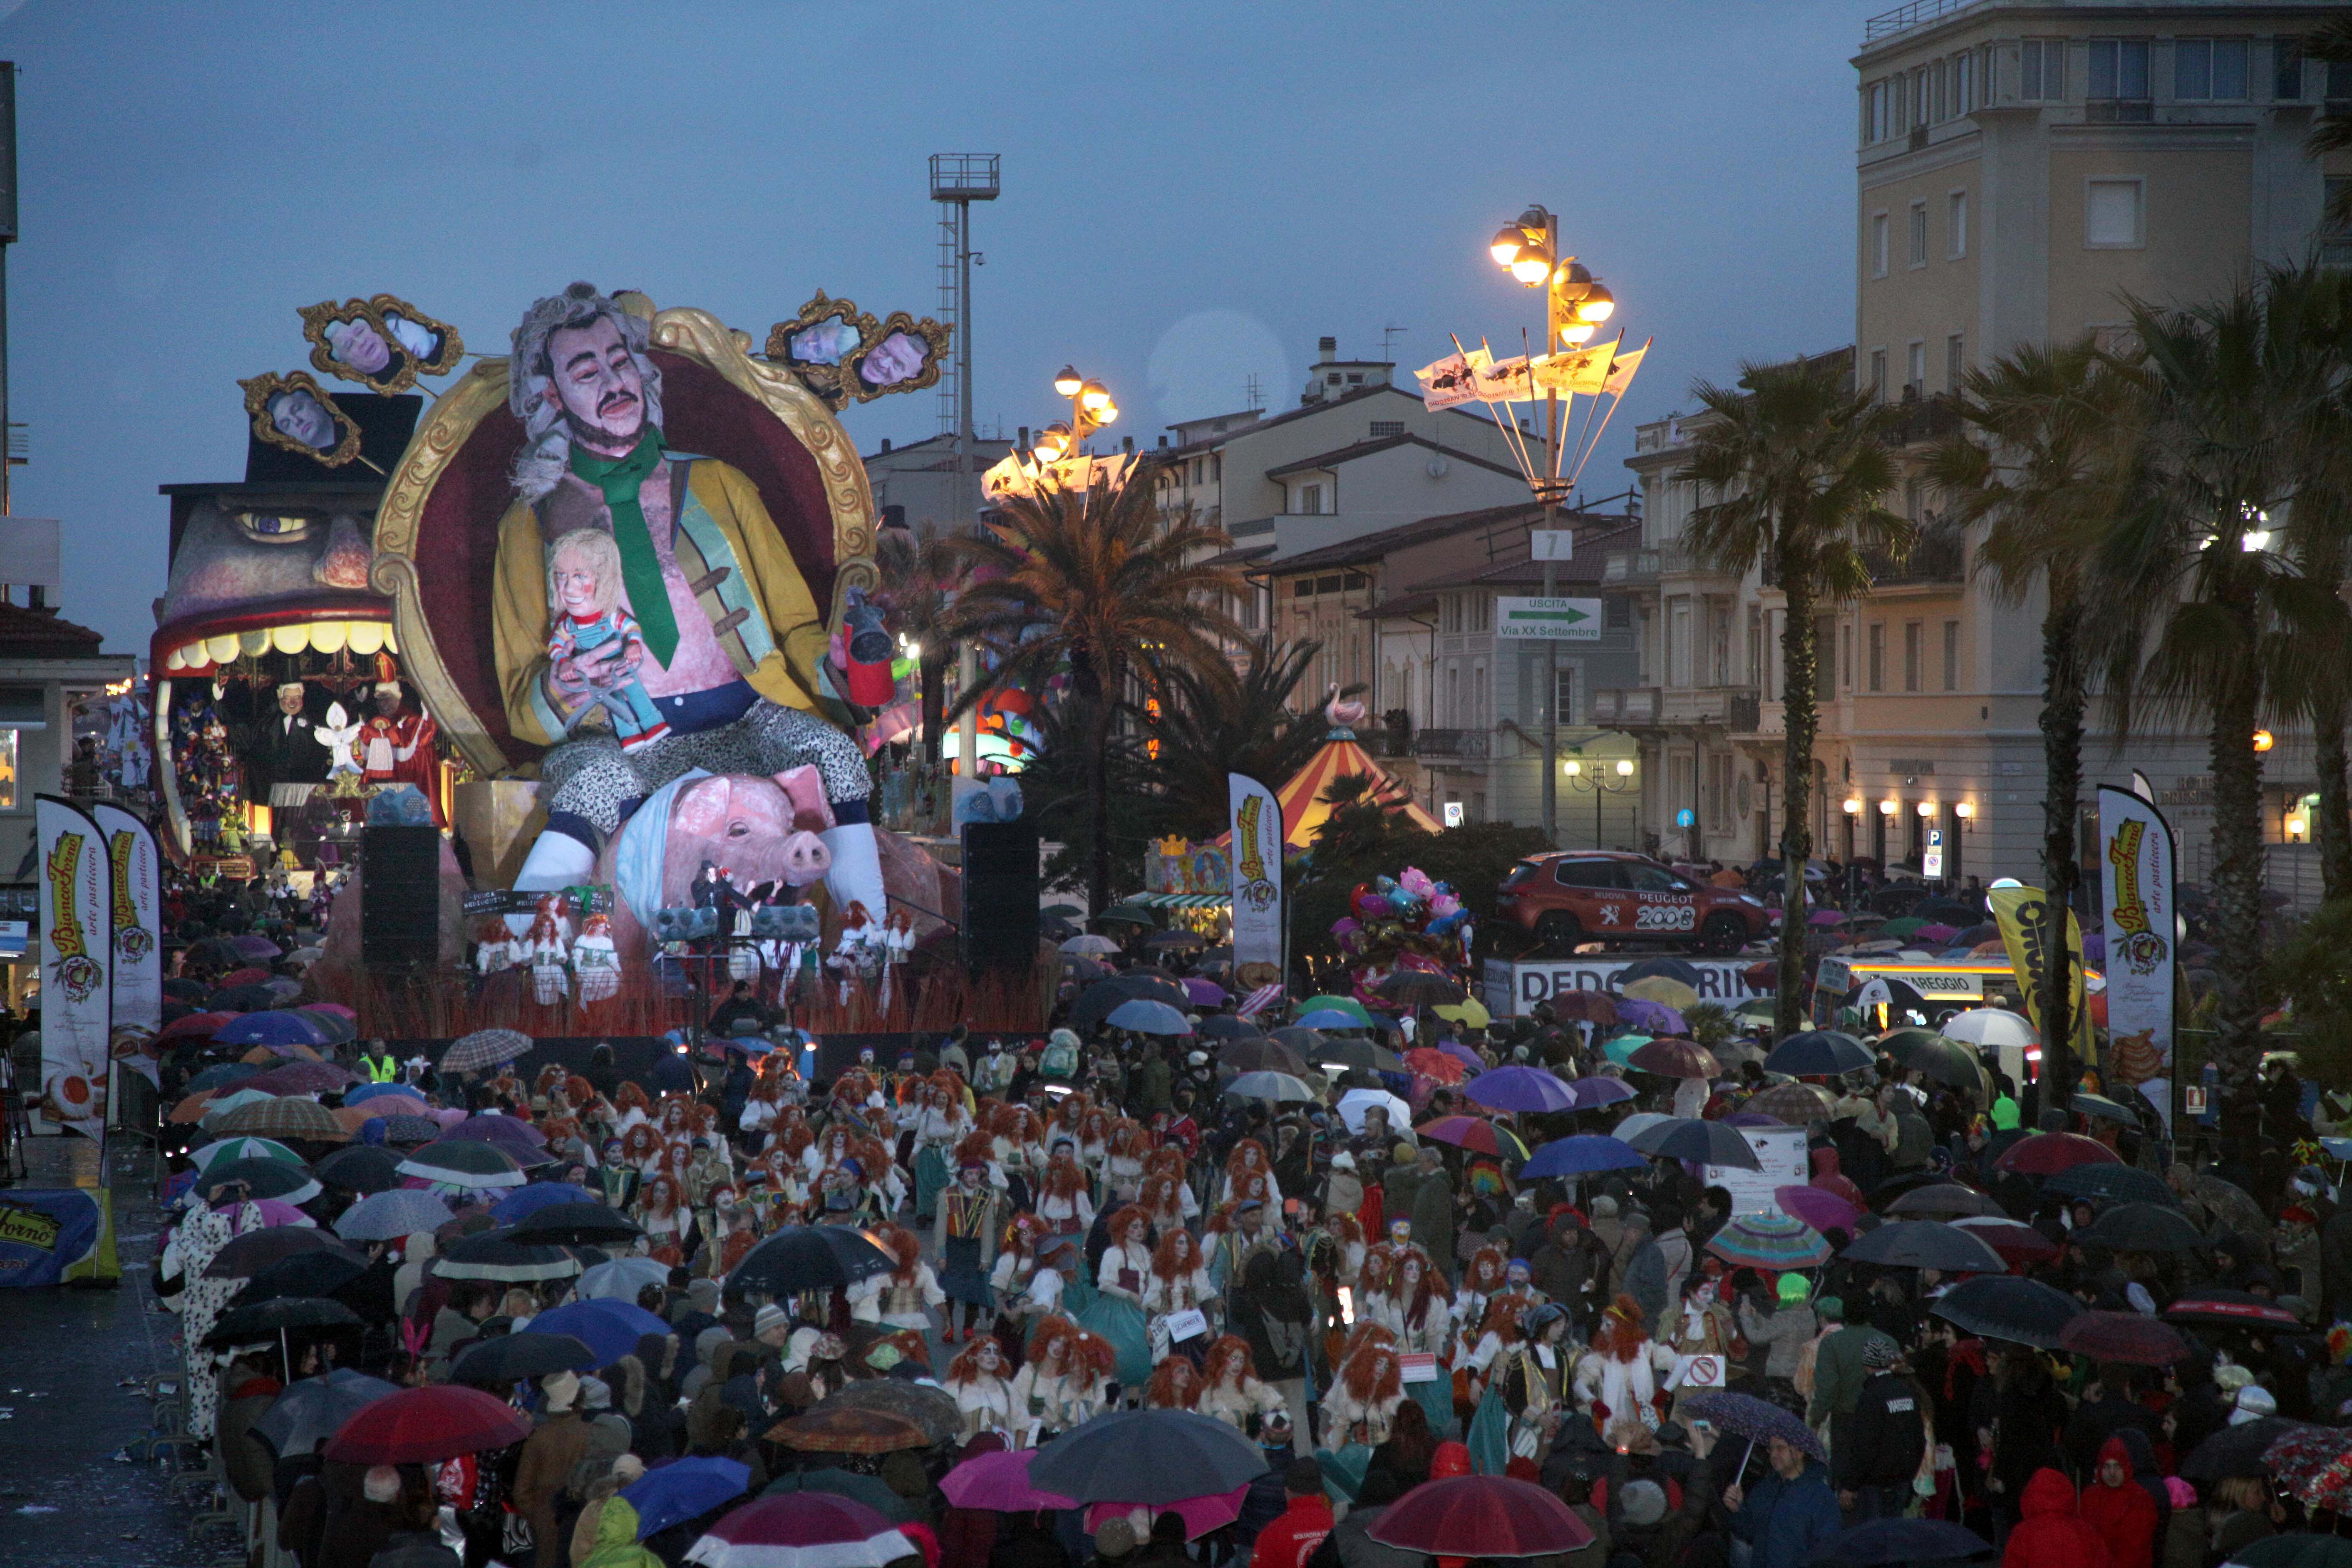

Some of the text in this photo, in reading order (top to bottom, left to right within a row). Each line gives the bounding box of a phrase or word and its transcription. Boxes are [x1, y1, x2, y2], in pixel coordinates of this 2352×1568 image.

[1529, 599, 1567, 608] USCITA
[1501, 626, 1597, 637] Via XX Settembre
[1640, 893, 1694, 904] PEUGEOT
[2151, 890, 2161, 913] arte
[88, 910, 97, 936] arte
[1635, 906, 1695, 930] 2008
[1293, 1532, 1321, 1541] SQUADRA
